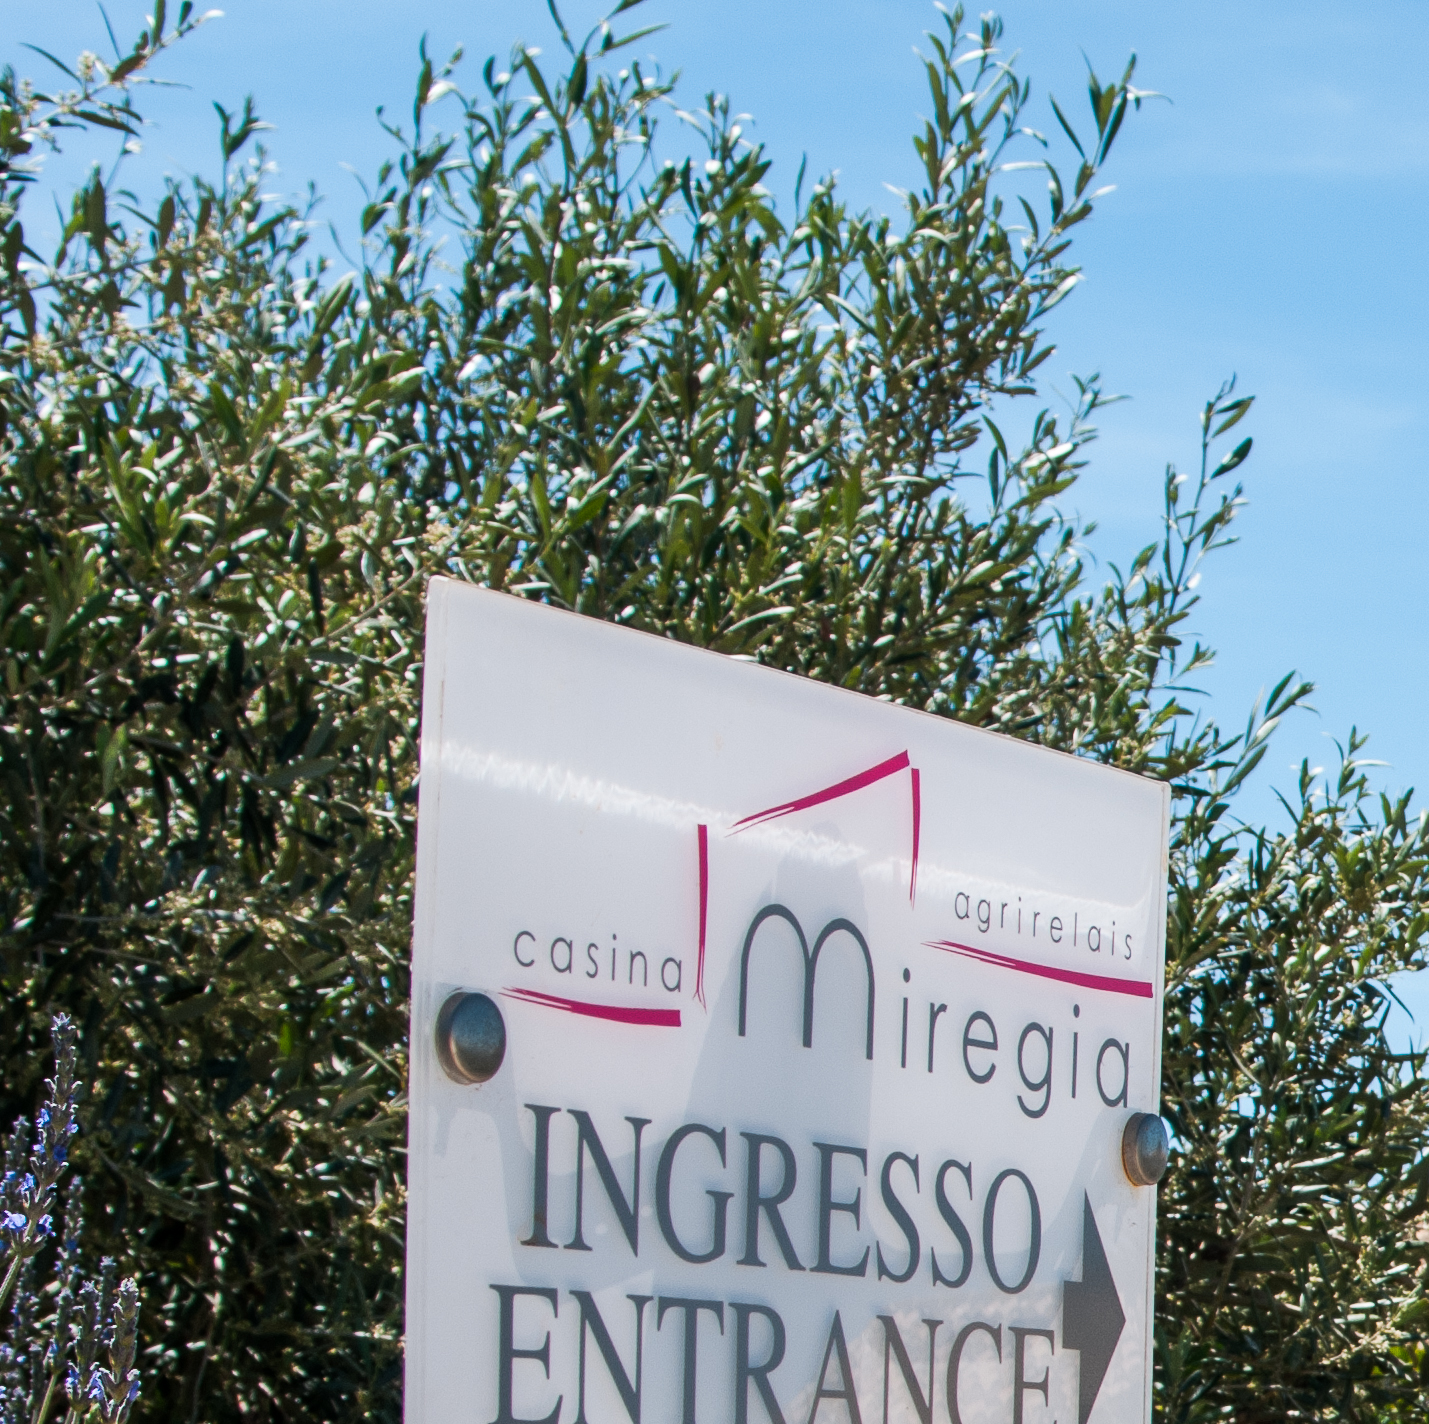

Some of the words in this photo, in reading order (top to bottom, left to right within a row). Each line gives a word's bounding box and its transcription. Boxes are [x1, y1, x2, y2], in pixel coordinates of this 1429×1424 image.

[514, 925, 682, 993] casina
[953, 890, 1133, 961] agrirelais
[520, 1103, 1042, 1295] INGRESSO
